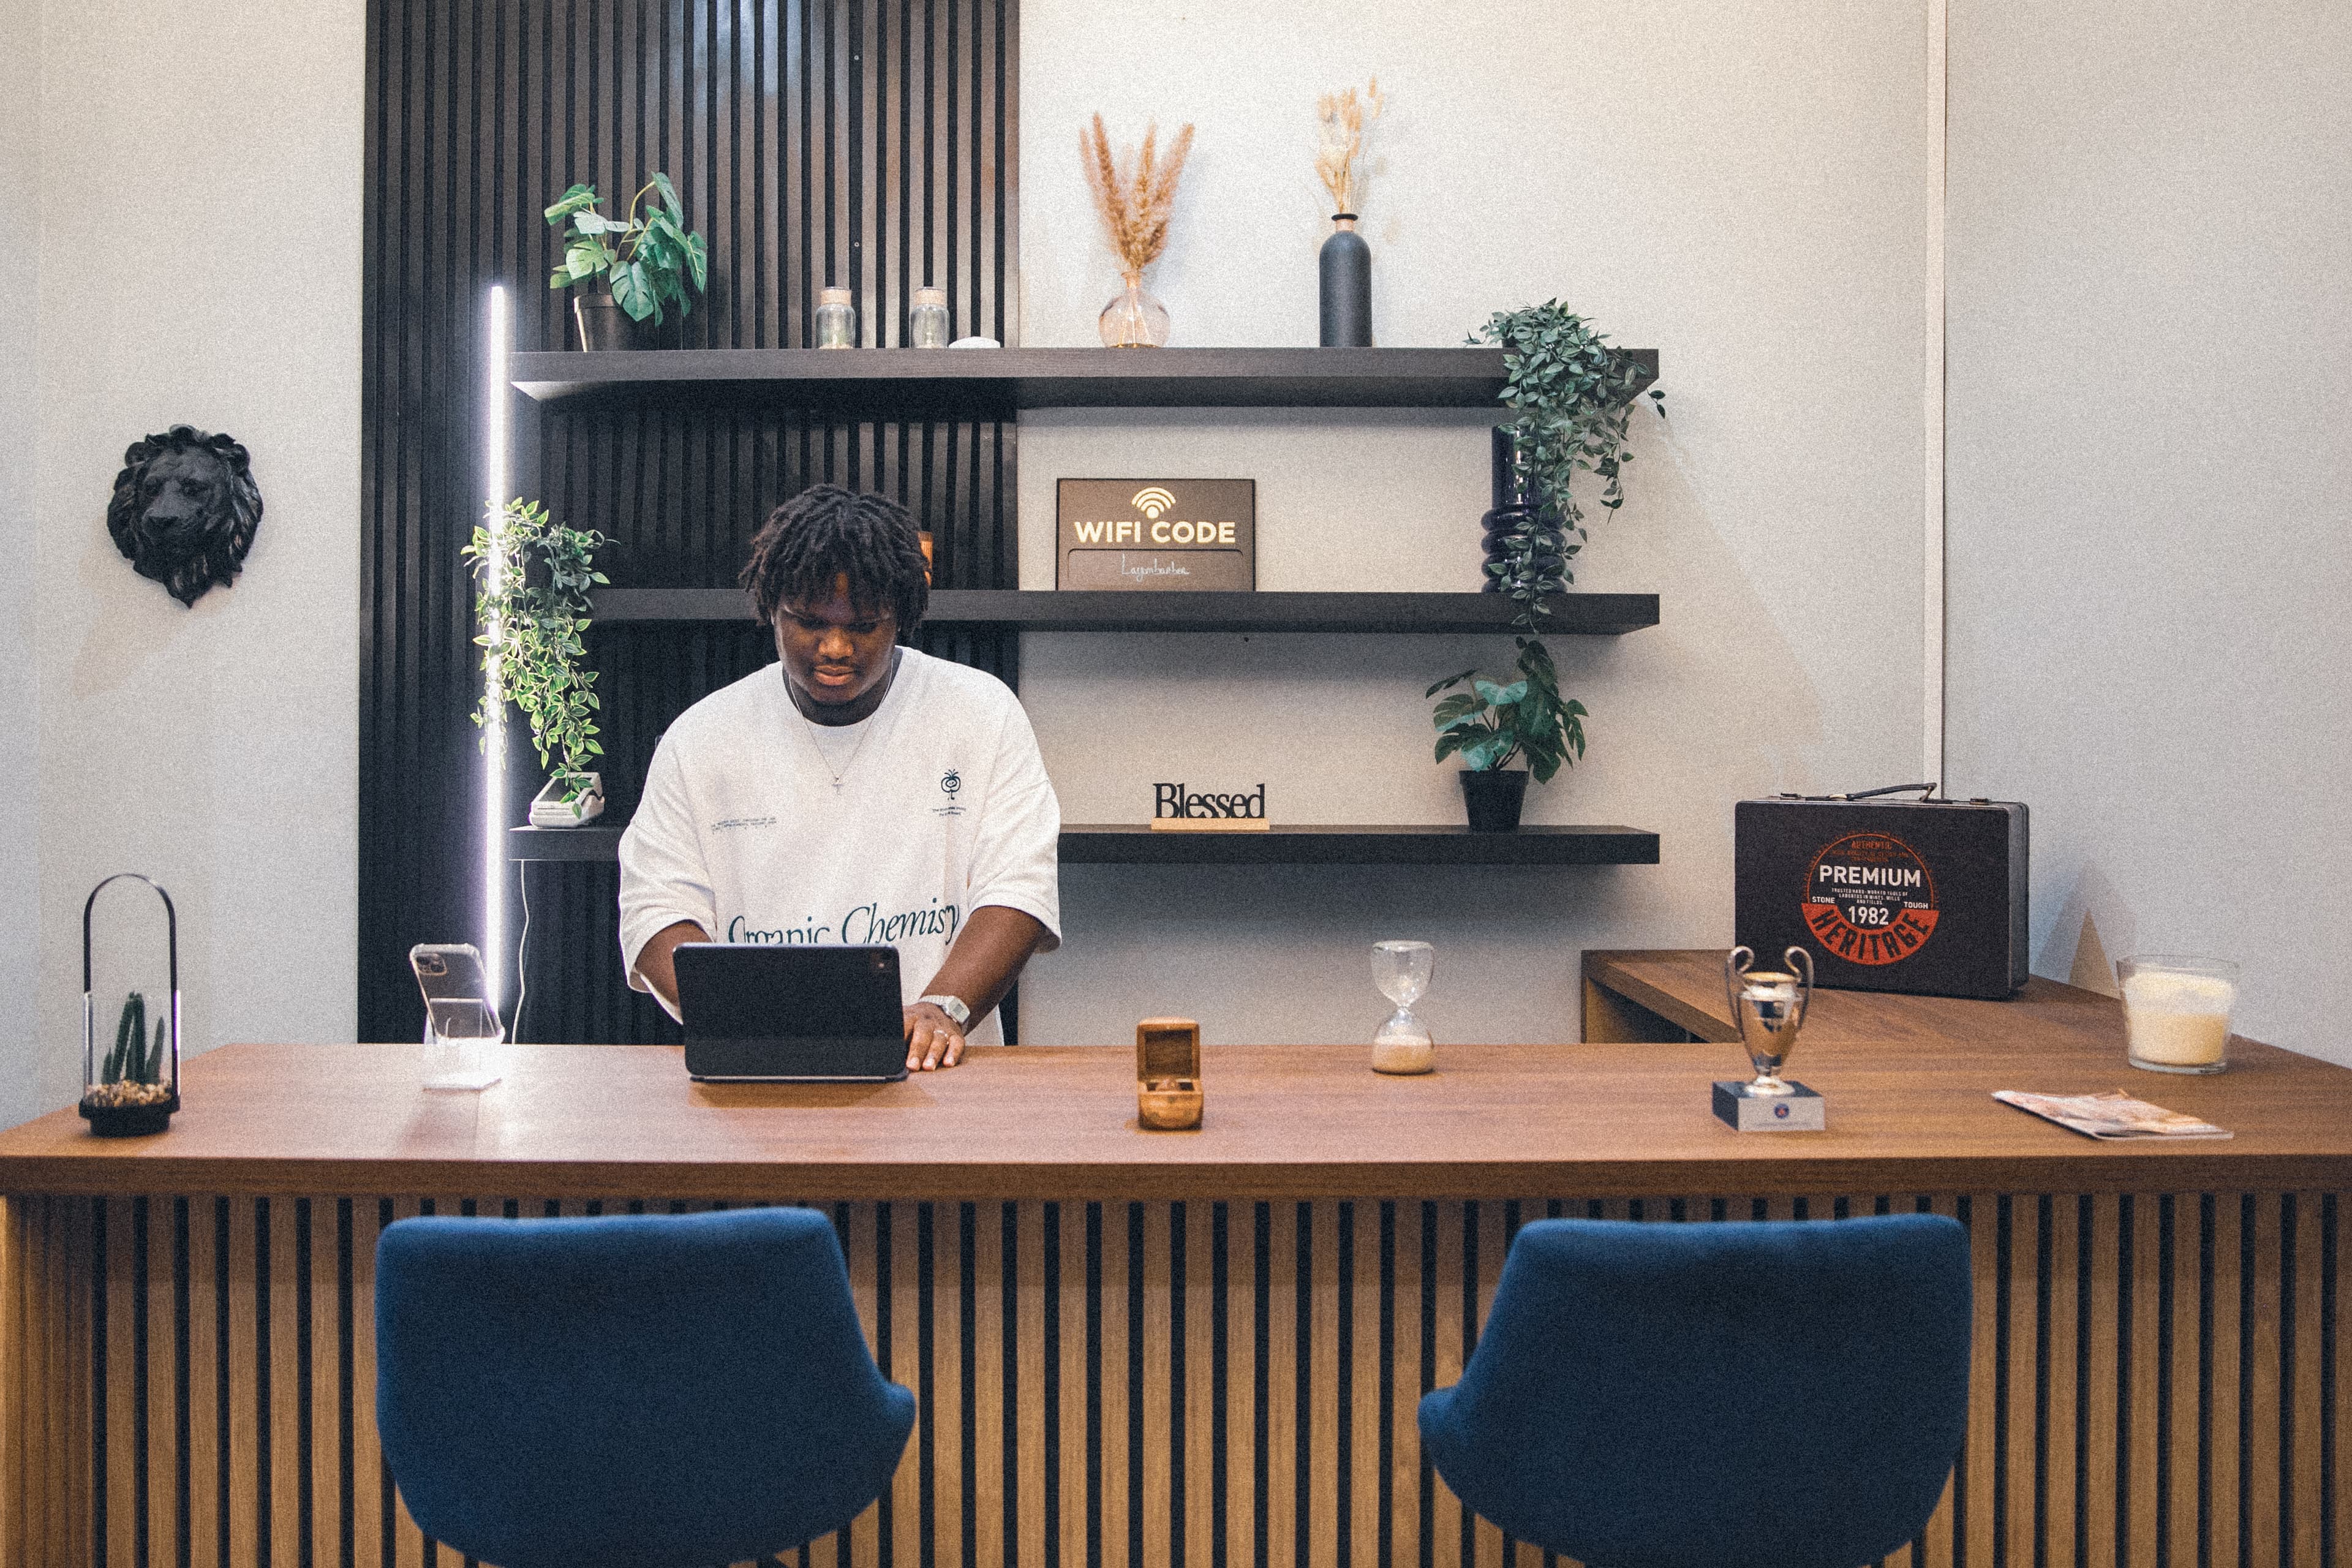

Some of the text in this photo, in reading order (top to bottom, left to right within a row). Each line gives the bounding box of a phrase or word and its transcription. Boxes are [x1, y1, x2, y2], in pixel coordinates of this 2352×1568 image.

[1074, 521, 1235, 544] WIFI CODE
[1152, 783, 1265, 818] Blessed
[1819, 865, 1921, 888] PREMIUM
[1849, 906, 1889, 925] 1982
[1904, 901, 1928, 910] TOUGH
[1812, 910, 1929, 960] HERITAGE
